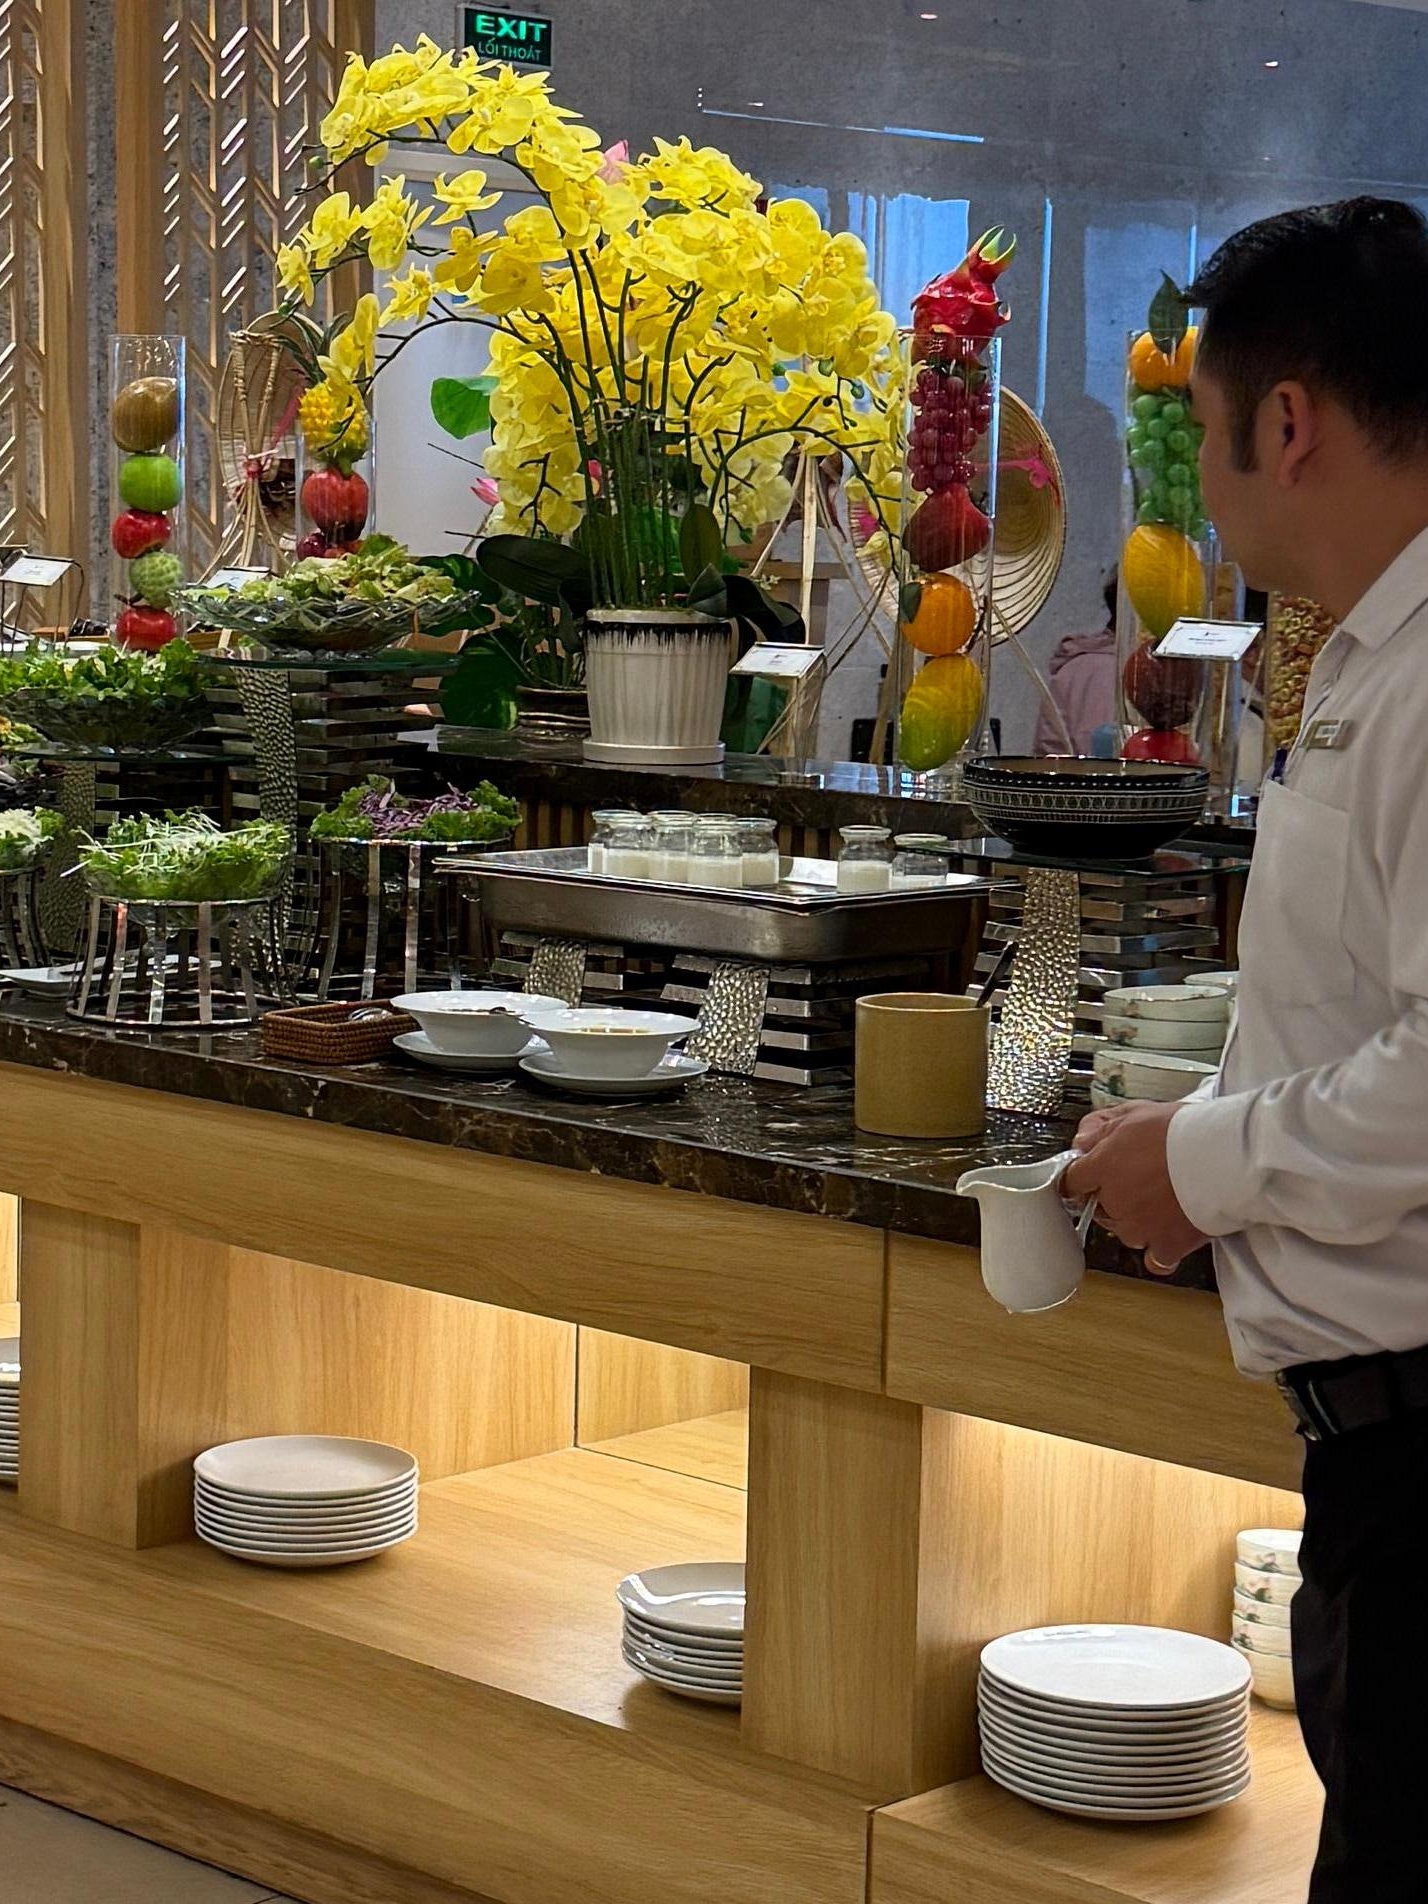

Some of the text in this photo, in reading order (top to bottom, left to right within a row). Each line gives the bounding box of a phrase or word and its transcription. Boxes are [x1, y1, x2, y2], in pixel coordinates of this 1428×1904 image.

[476, 14, 548, 42] EXIT
[478, 37, 542, 61] LỐI THOÁT
